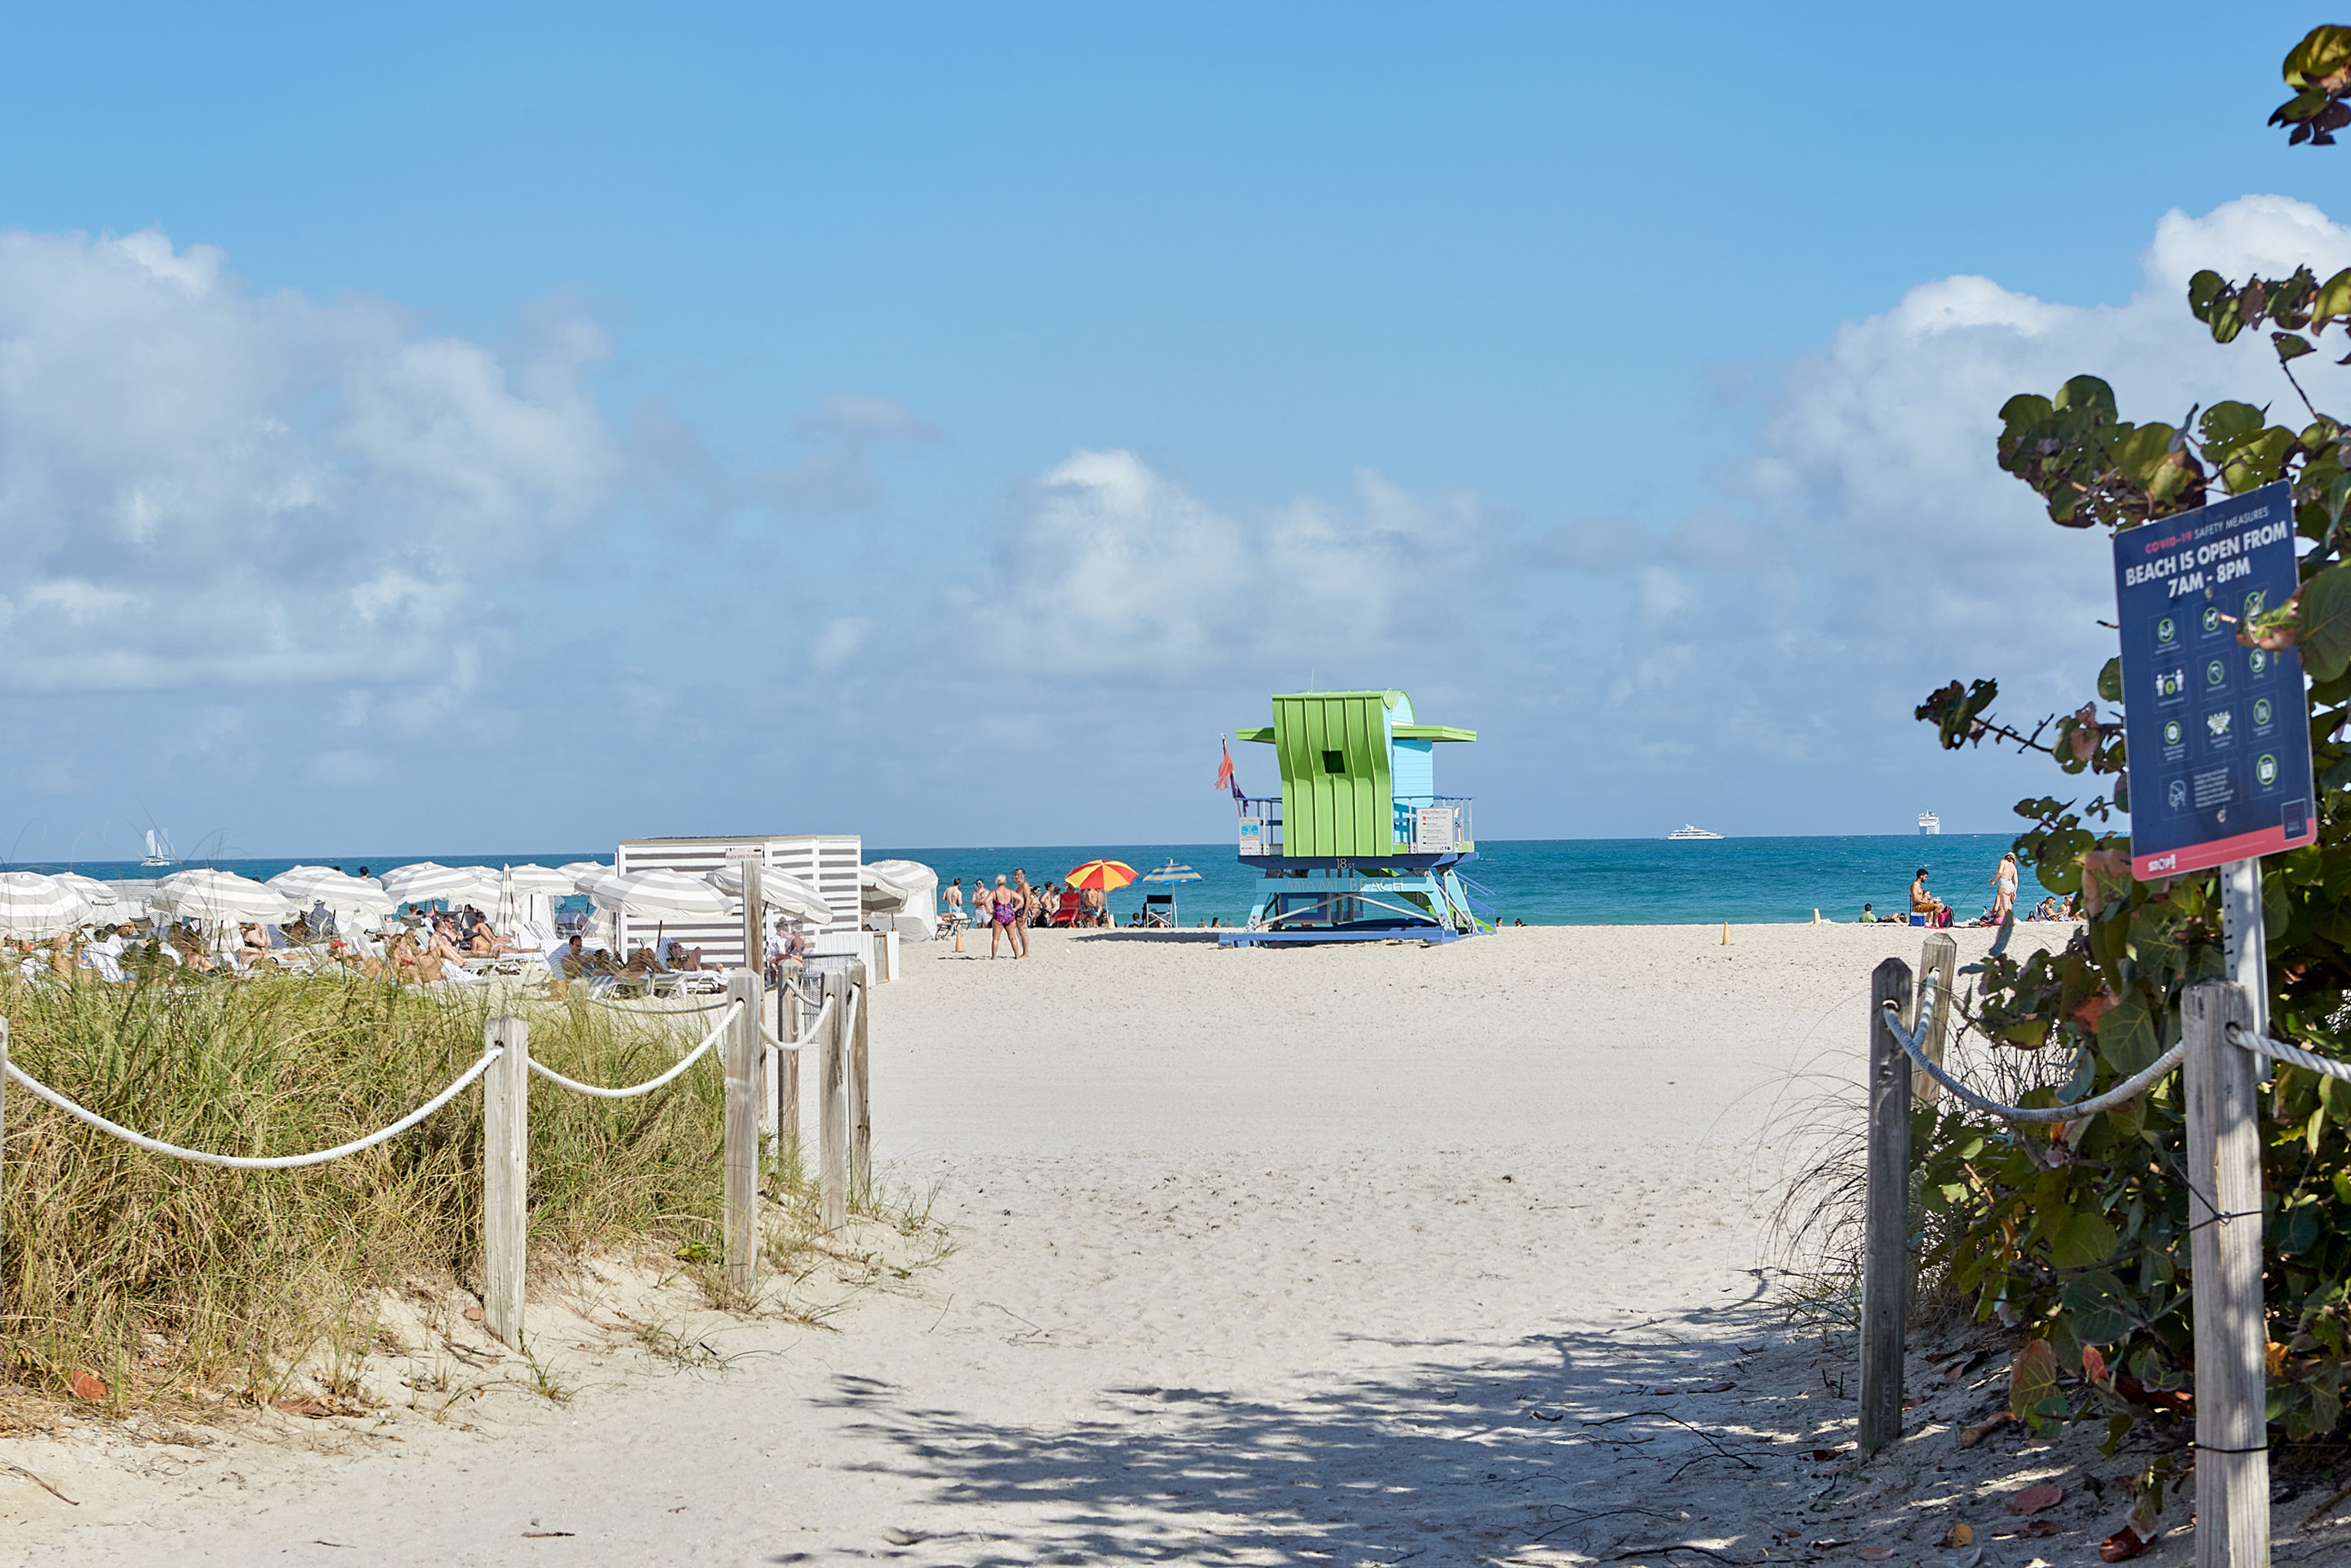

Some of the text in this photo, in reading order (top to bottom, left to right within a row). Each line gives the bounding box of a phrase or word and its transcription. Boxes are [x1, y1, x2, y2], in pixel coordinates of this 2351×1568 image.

[2145, 505, 2269, 554] COVID-19 SAFETY MEASURES
[2125, 520, 2288, 586] BEACH IS OPEN FROM
[2167, 571, 2204, 598] 7AM
[2216, 556, 2251, 584] 8PM
[1287, 877, 1404, 892] MIAMI BEACH
[1336, 858, 1347, 869] 18
